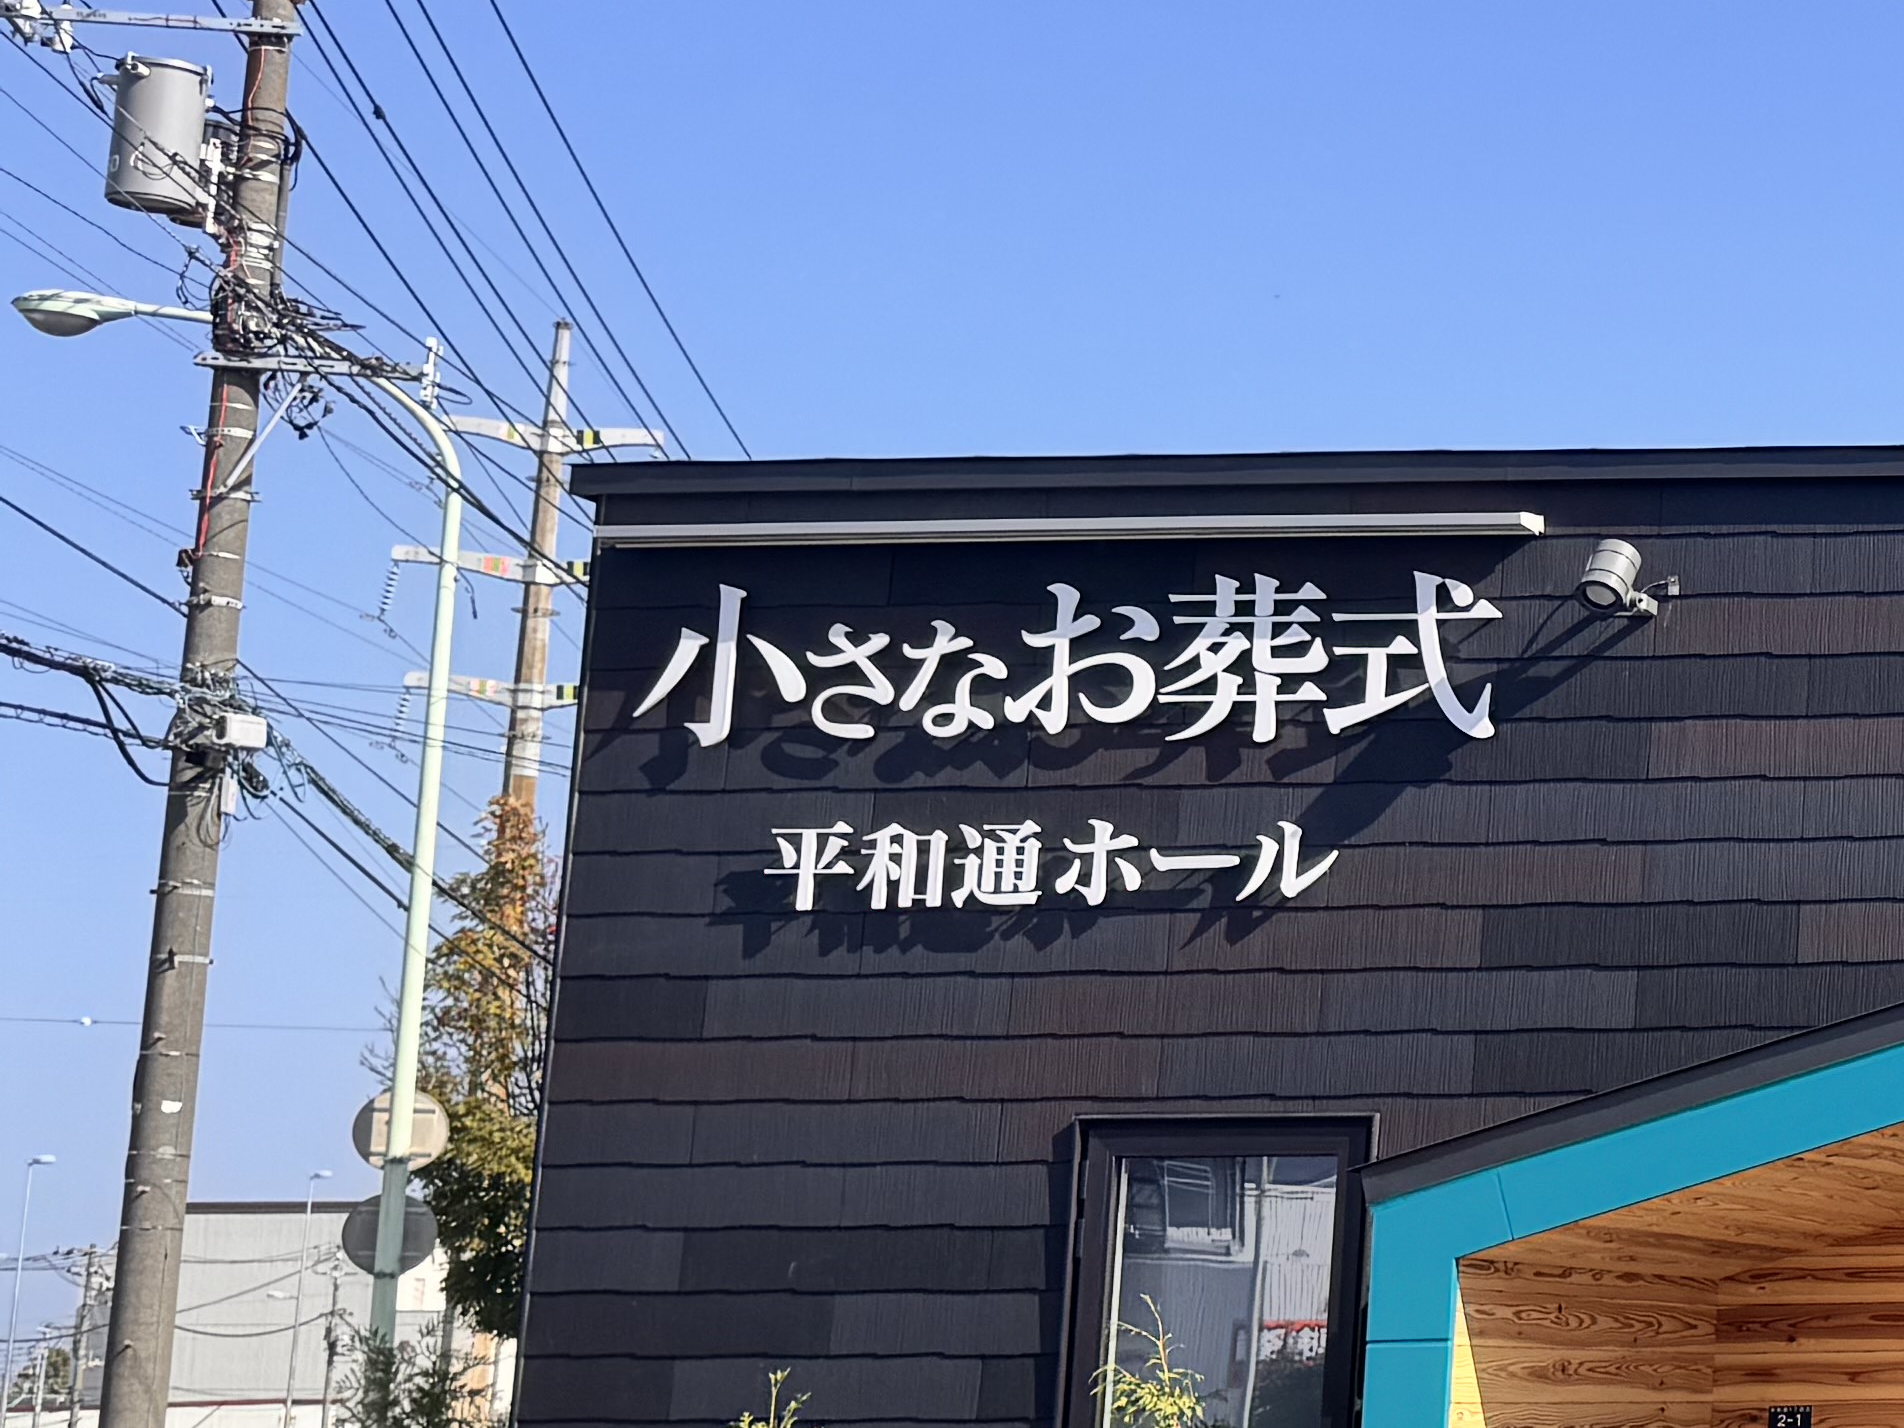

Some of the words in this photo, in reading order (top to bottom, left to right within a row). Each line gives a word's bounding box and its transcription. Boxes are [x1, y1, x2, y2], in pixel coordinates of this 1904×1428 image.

[633, 571, 1502, 747] 小さなお葬式
[764, 819, 1339, 911] 平和通ホール
[1777, 1414, 1801, 1427] 2-1
